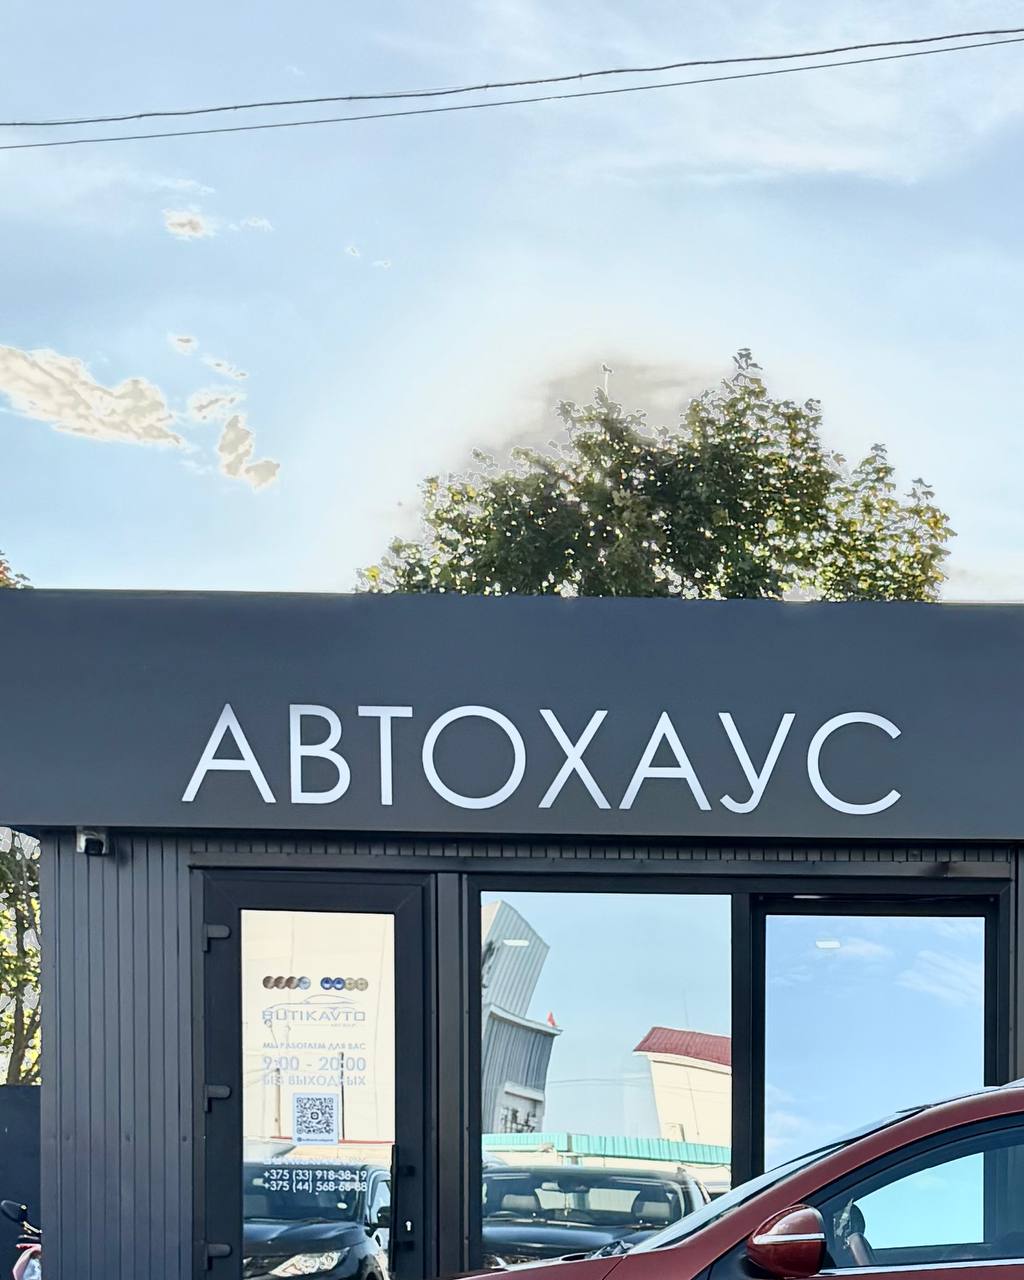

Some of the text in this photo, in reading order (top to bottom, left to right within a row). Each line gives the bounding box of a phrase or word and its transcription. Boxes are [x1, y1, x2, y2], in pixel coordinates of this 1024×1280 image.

[181, 703, 902, 815] АВТОХАУС
[262, 1008, 366, 1022] BUTIKAVTO
[263, 1169, 367, 1182] +375 (33) 918-38-19
[263, 1181, 290, 1191] +375
[292, 1181, 312, 1193] (44)
